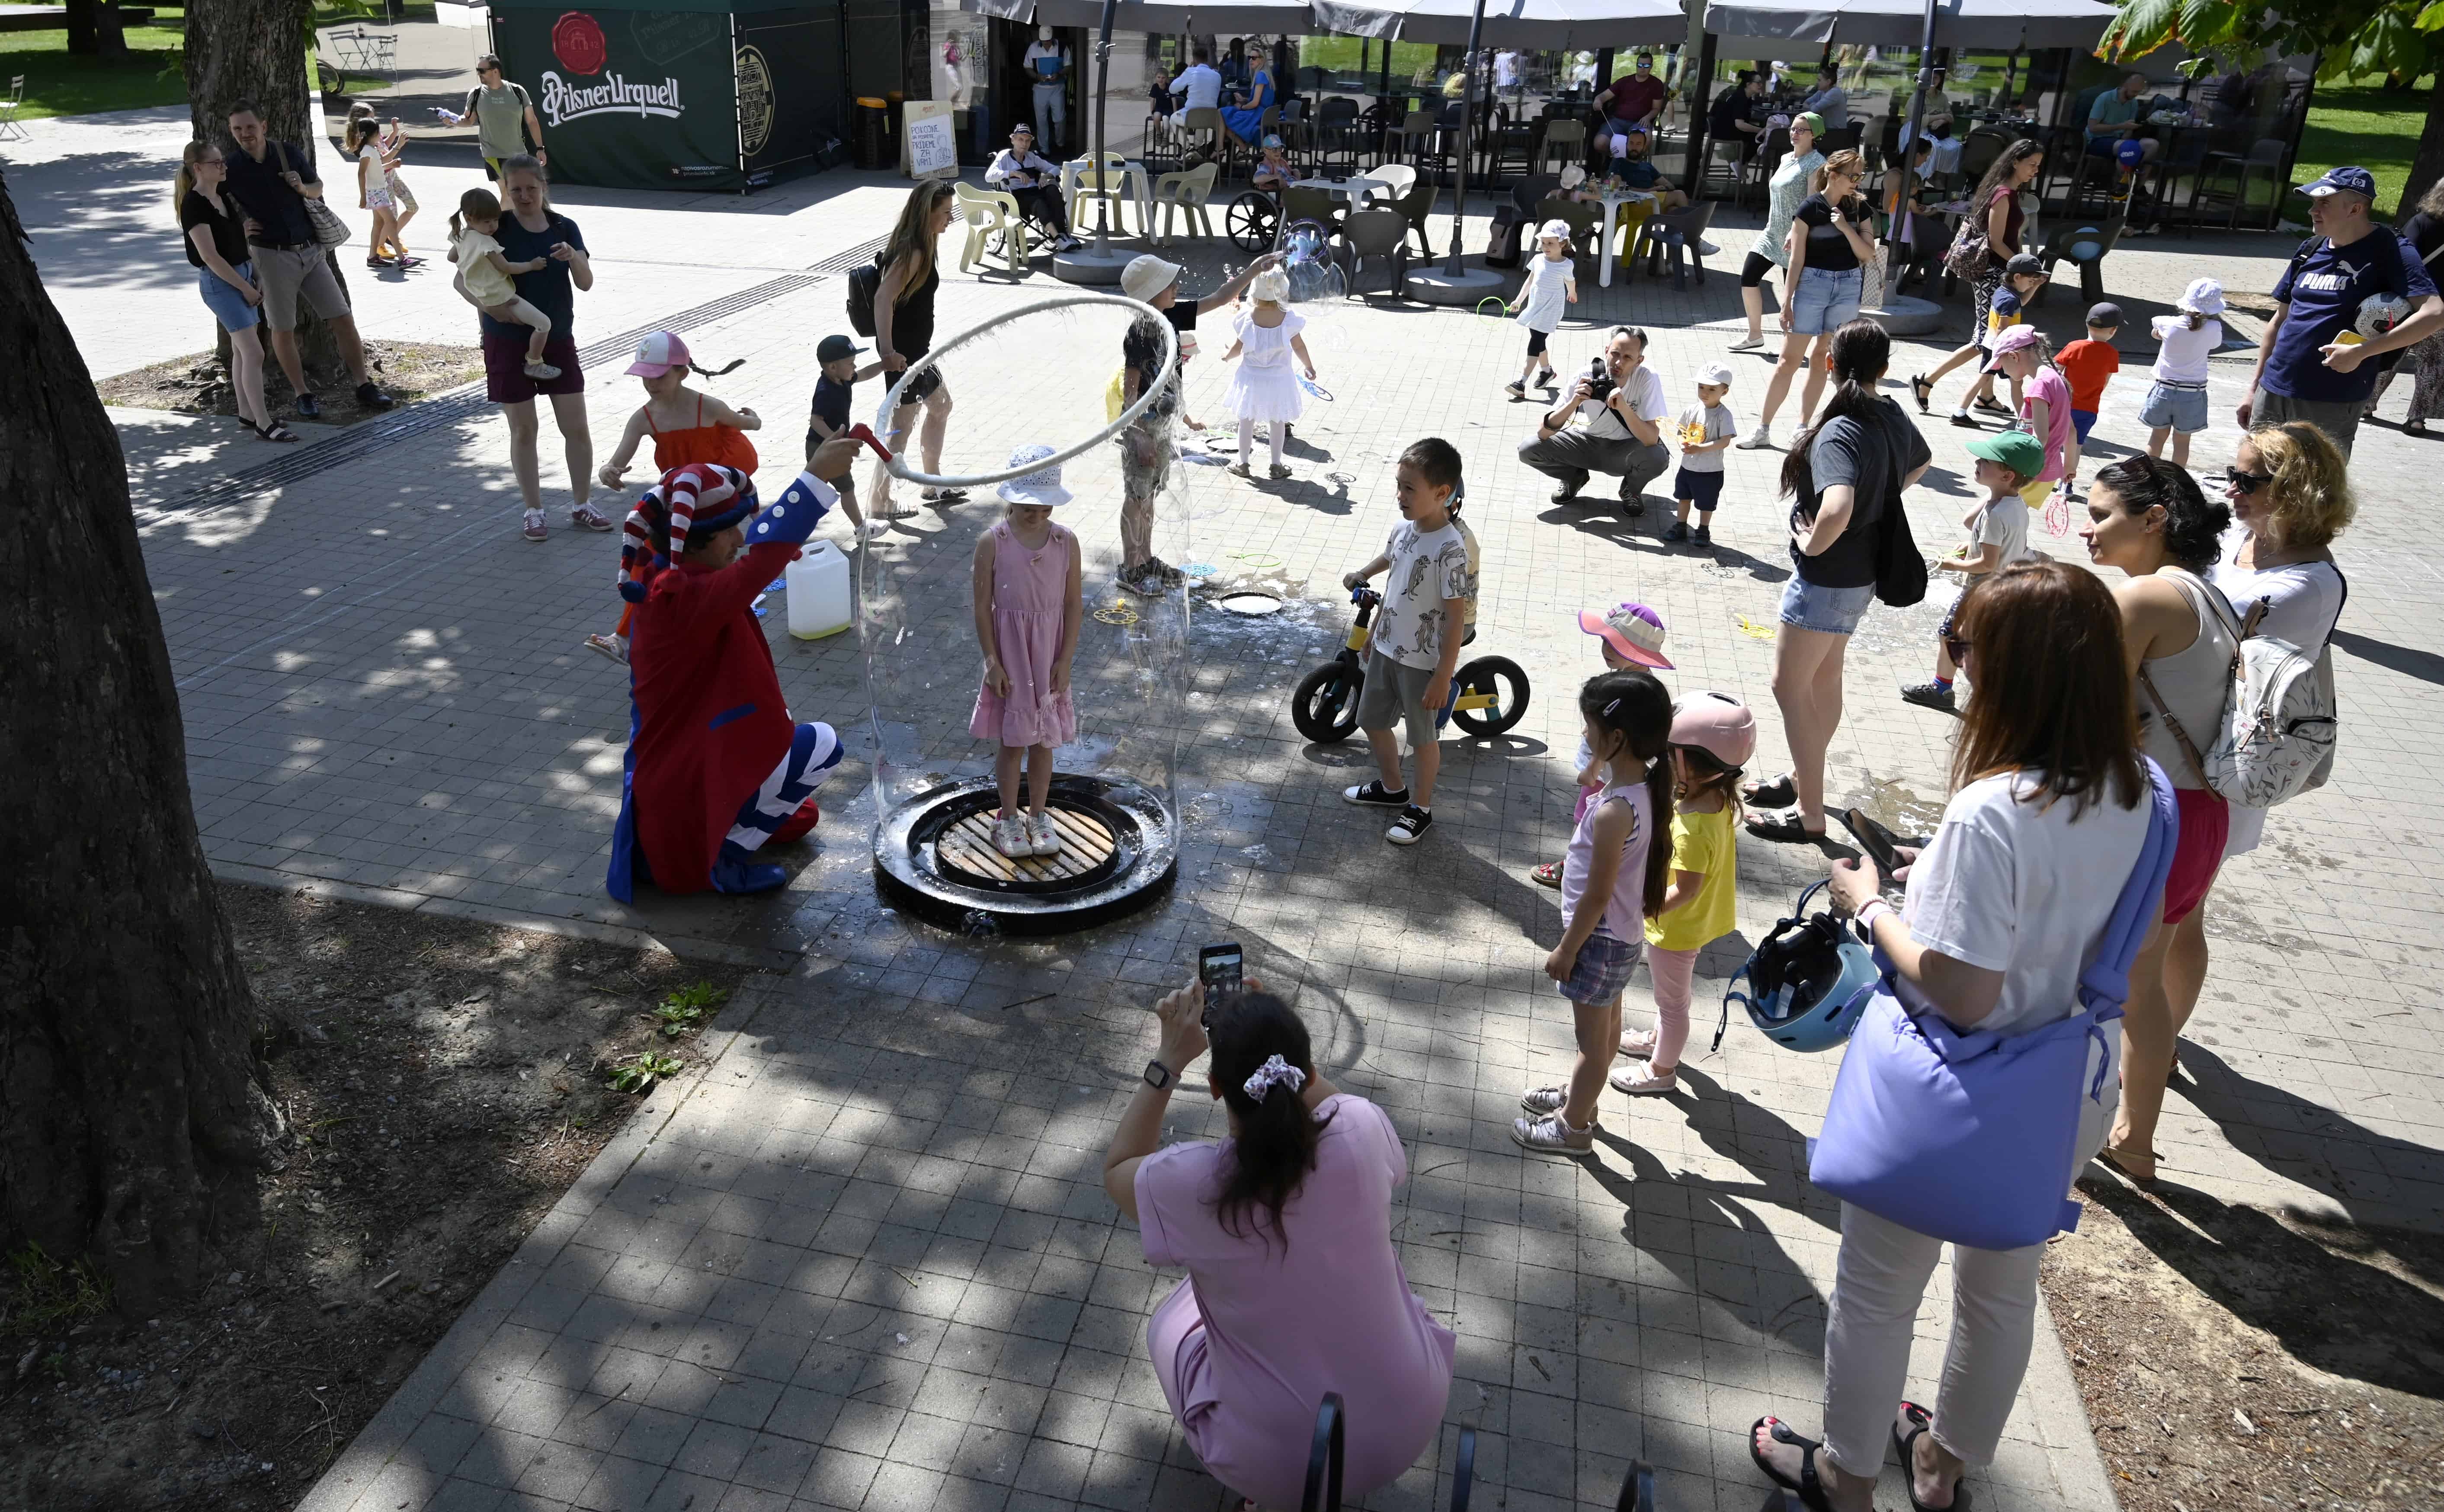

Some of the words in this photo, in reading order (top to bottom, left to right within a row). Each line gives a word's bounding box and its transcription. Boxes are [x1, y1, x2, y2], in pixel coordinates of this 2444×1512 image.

[541, 71, 610, 126] Pilsner
[606, 70, 679, 119] Urquell
[911, 124, 939, 135] POKOJNE
[916, 157, 932, 166] VAMI
[2299, 273, 2349, 290] PUMA
